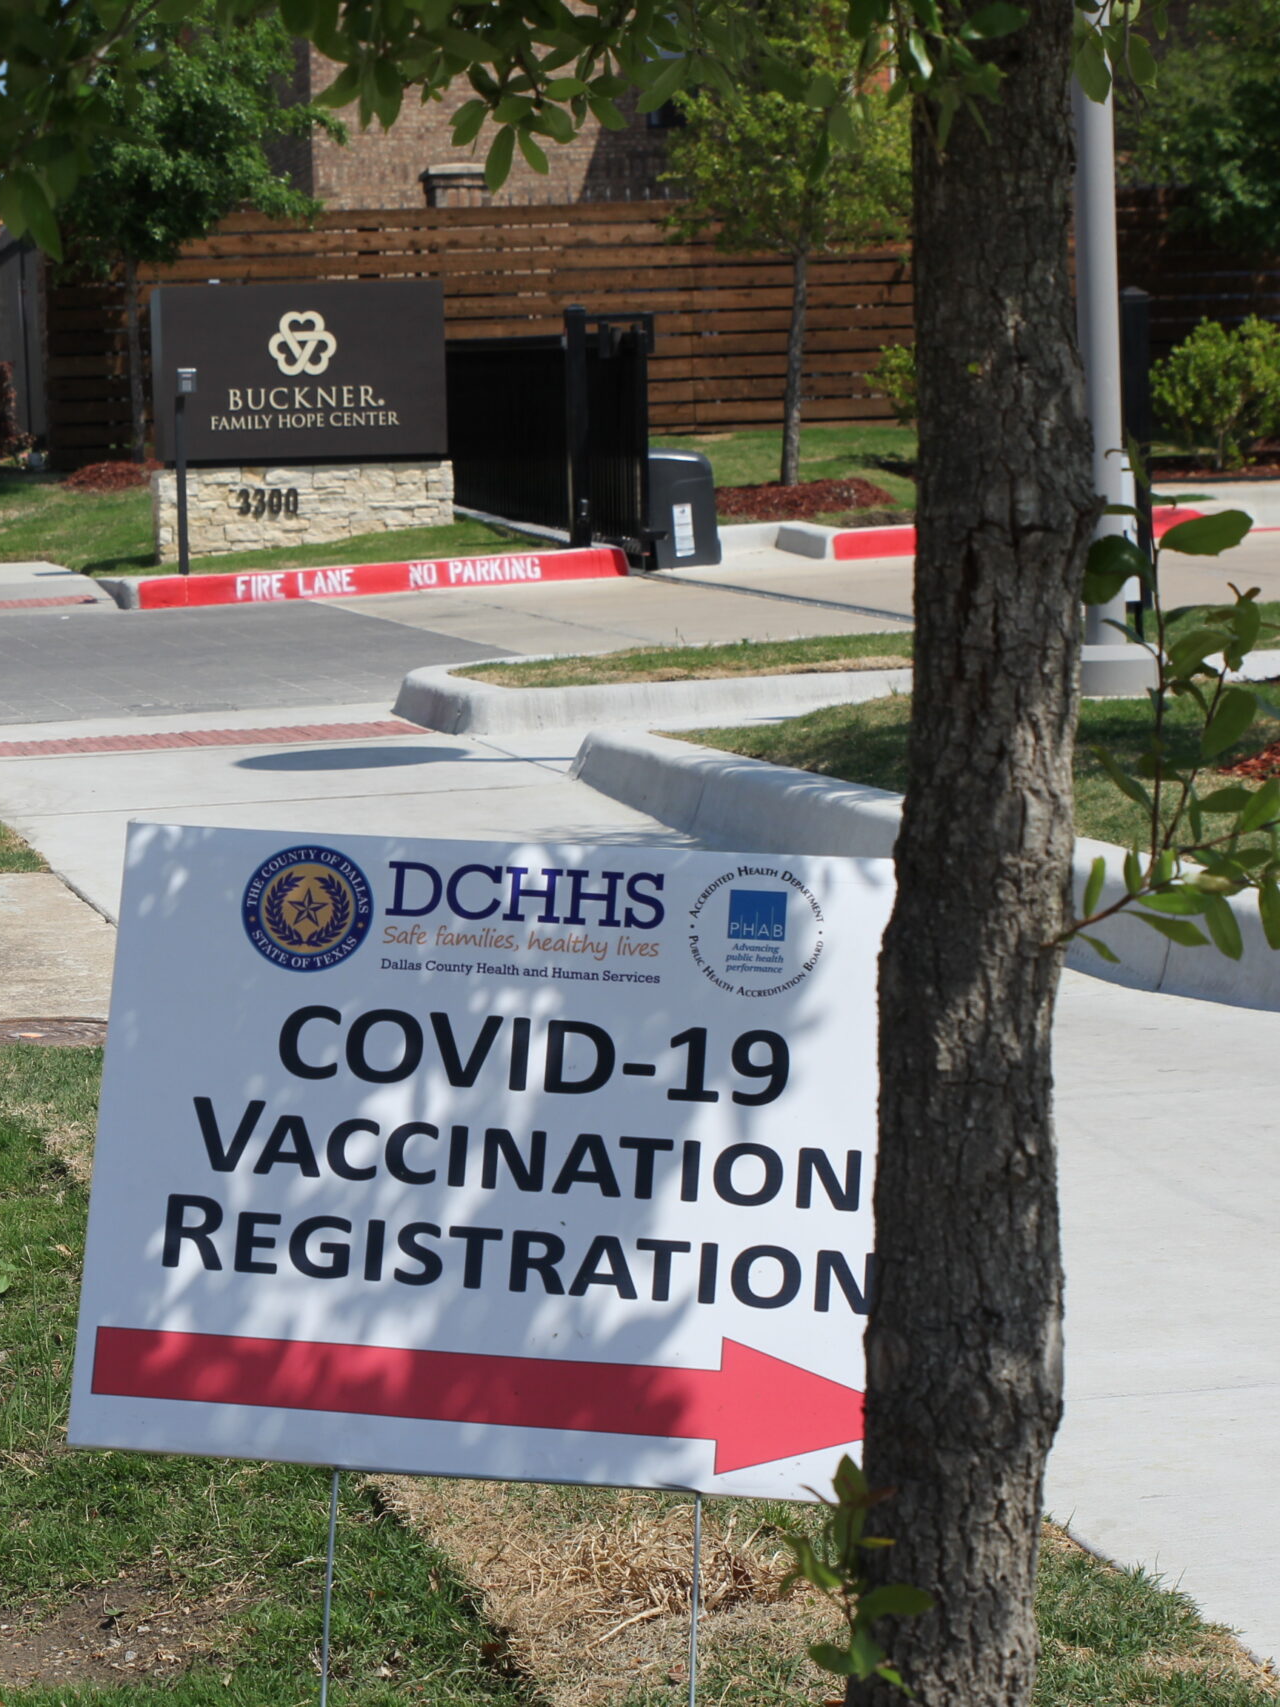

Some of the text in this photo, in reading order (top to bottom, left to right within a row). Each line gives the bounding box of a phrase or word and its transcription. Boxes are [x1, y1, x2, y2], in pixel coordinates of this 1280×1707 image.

[210, 411, 400, 431] FAMILY HOPE CENTER
[236, 487, 299, 515] 3300
[236, 557, 542, 600] FIRE LANE NO PARKING
[247, 849, 369, 914] THE COUNTY OF DALLAS
[385, 861, 665, 930] DCHHS
[689, 865, 824, 923] ACCREDITED HEALTH DEPARTMENT
[252, 929, 357, 969] STATE OF TEXAS
[382, 924, 660, 961] Safe families, healthy lives
[729, 922, 783, 938] PHAB
[732, 943, 780, 954] Advancing
[380, 958, 660, 984] Dallas County Health and Human Services
[689, 935, 824, 998] PUBLIC HEALTH ACCREDITATION BOARD
[725, 952, 784, 963] public health
[725, 962, 783, 974] performance
[278, 1005, 791, 1106] COVID-19
[193, 1096, 863, 1212] VACCINATION
[161, 1194, 876, 1316] REGISTRATION
